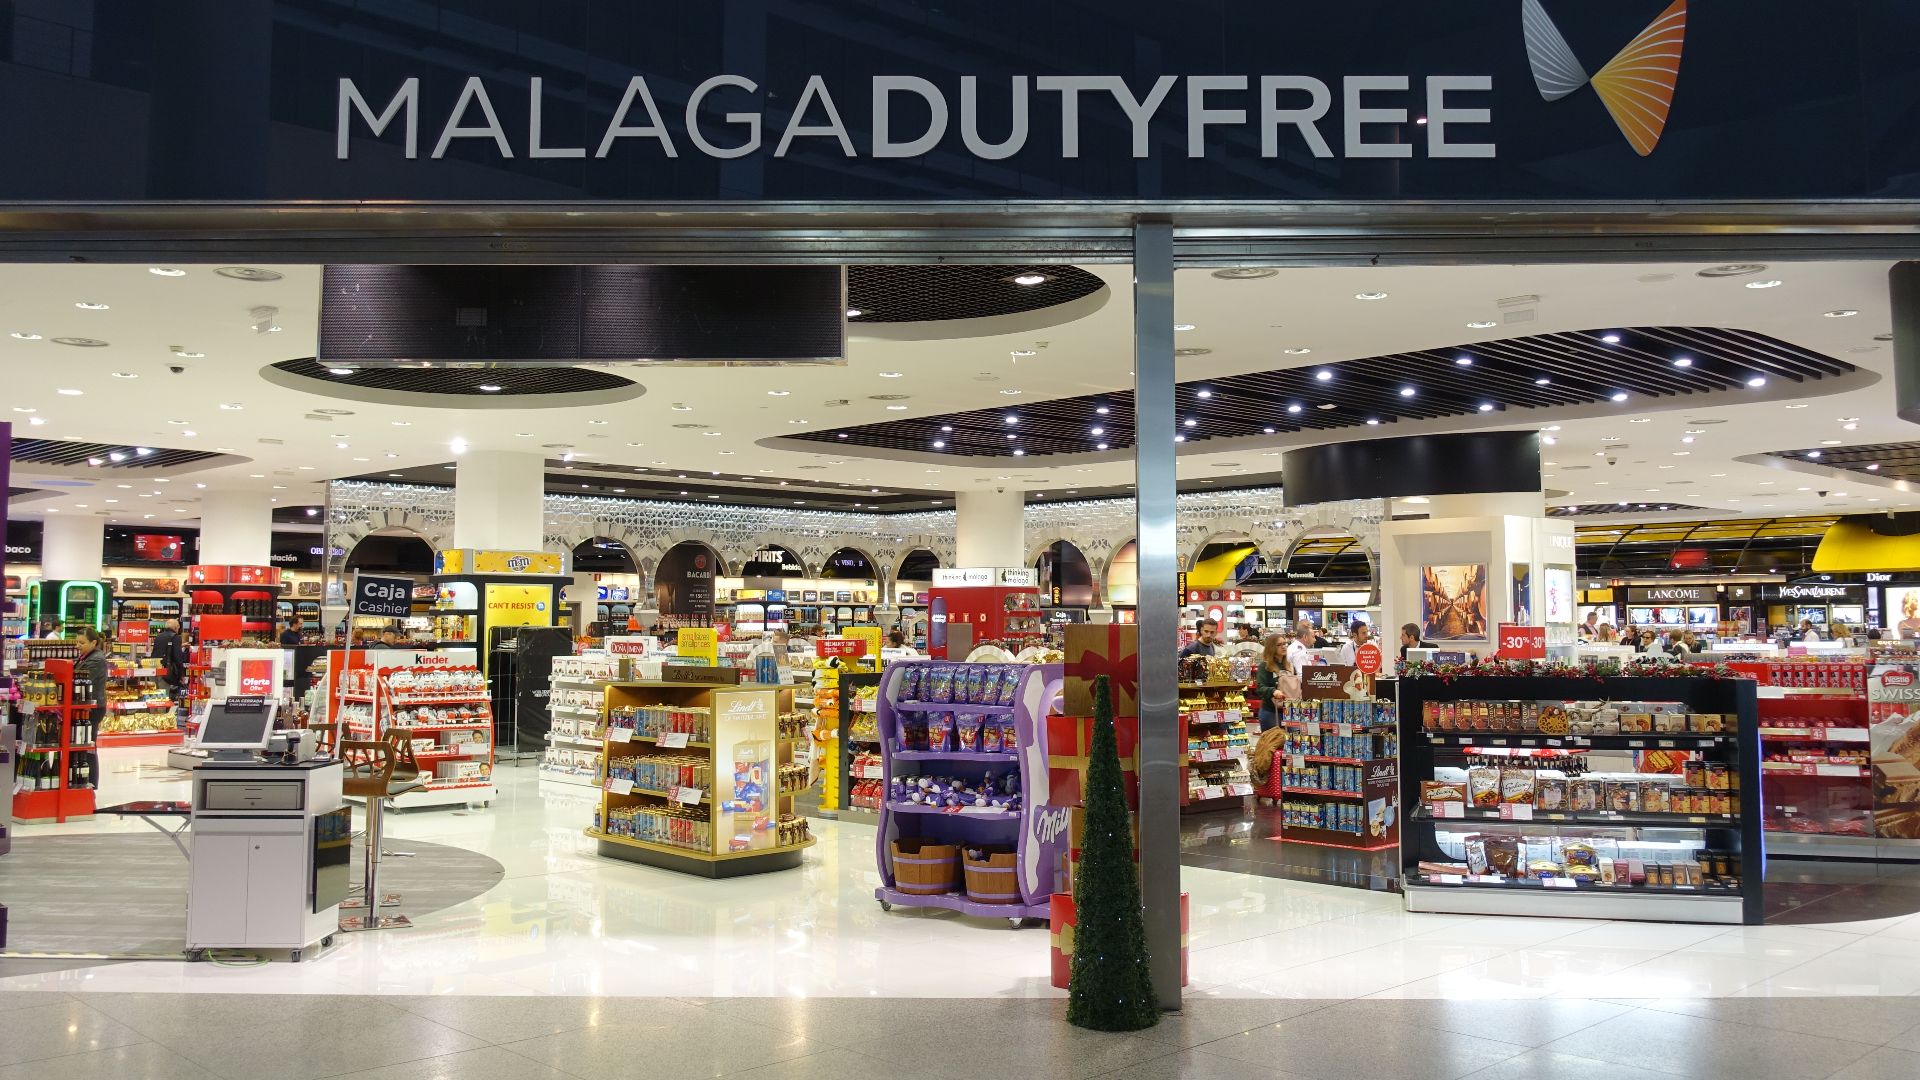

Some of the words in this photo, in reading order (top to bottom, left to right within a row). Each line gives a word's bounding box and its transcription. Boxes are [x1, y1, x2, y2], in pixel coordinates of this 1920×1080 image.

[750, 551, 783, 563] PIRITS
[1866, 573, 1892, 582] Dior
[364, 582, 406, 601] Caja
[358, 600, 409, 615] Cashier
[488, 602, 510, 610] CAN'T
[511, 602, 535, 610] RESIST
[1502, 636, 1529, 649] -30%
[243, 678, 271, 687] Oferta
[727, 698, 756, 713] Lindt
